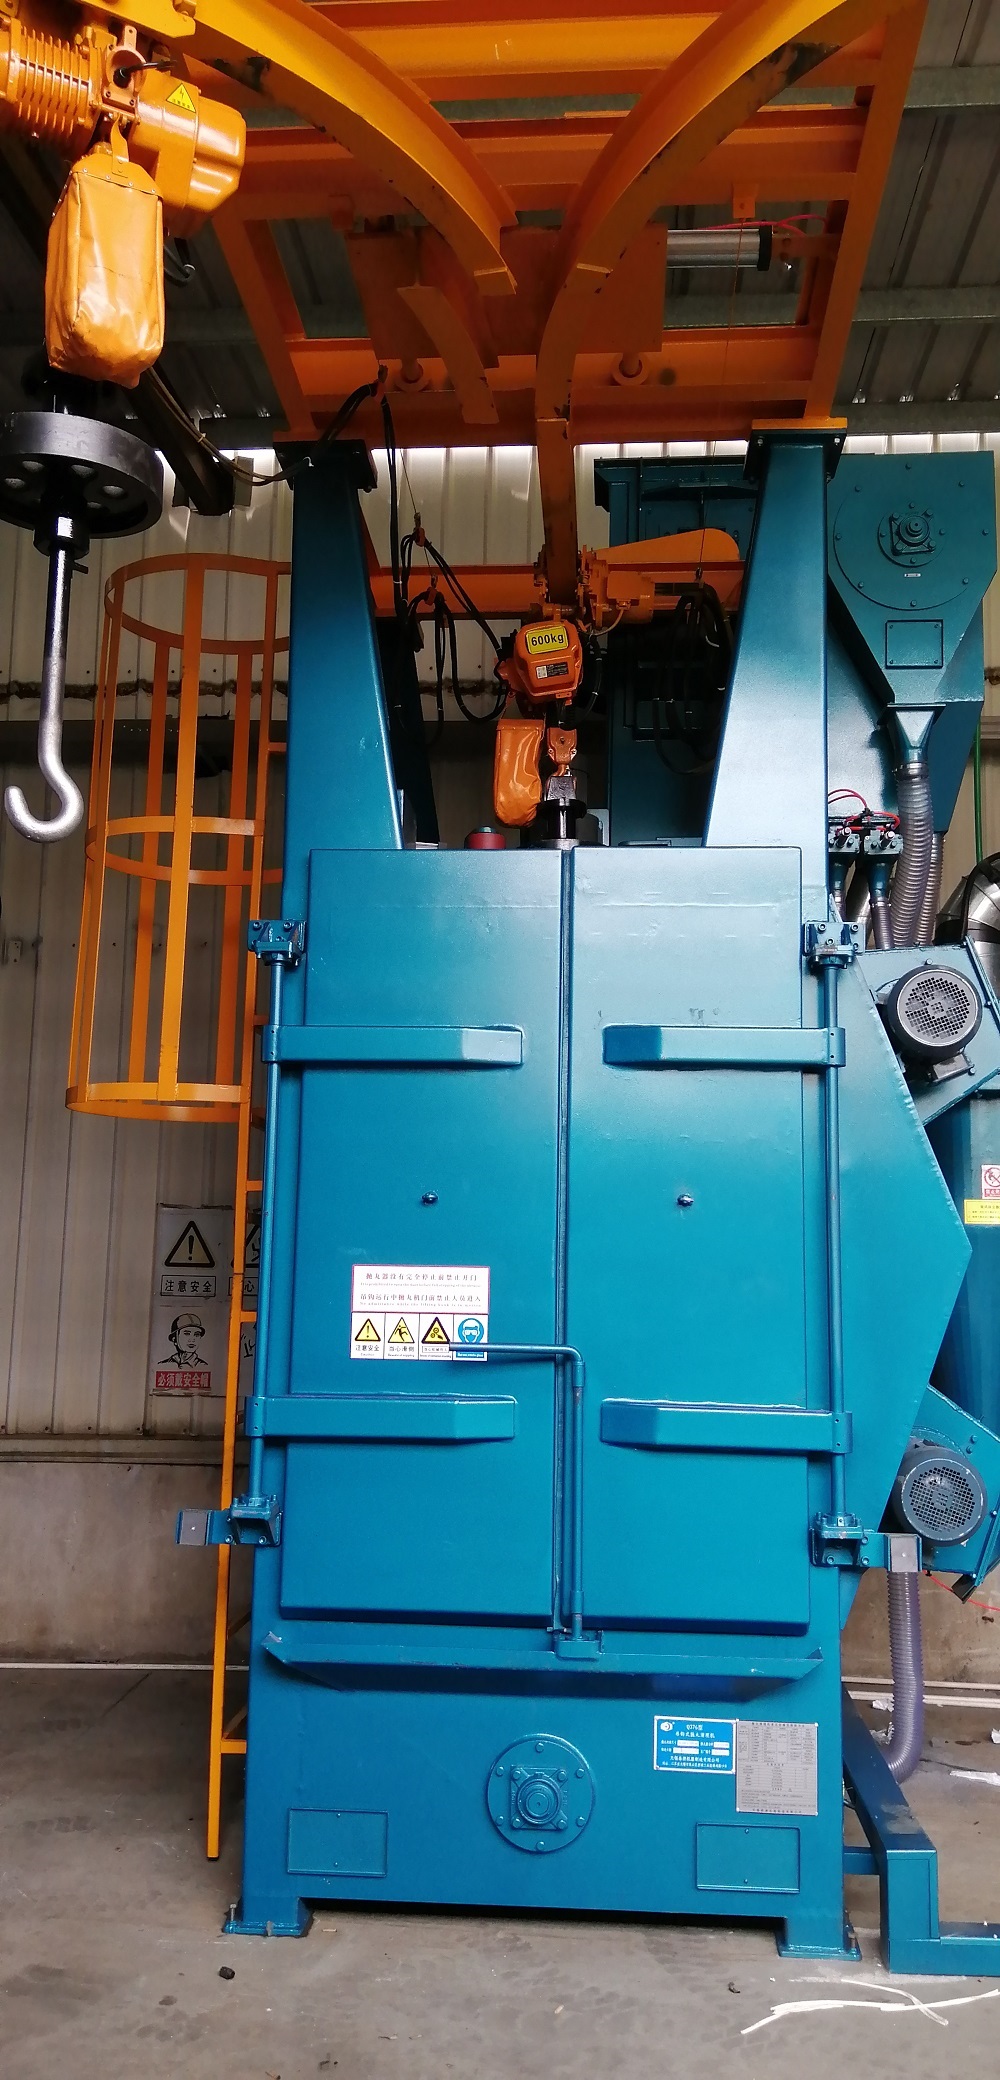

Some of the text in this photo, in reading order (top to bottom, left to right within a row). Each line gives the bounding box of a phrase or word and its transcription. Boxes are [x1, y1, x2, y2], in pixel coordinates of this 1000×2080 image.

[531, 633, 564, 646] 600kg
[164, 1280, 212, 1293] 注意安全
[355, 1344, 380, 1352] 注意安全
[158, 1373, 210, 1388] 必须戴安全帽
